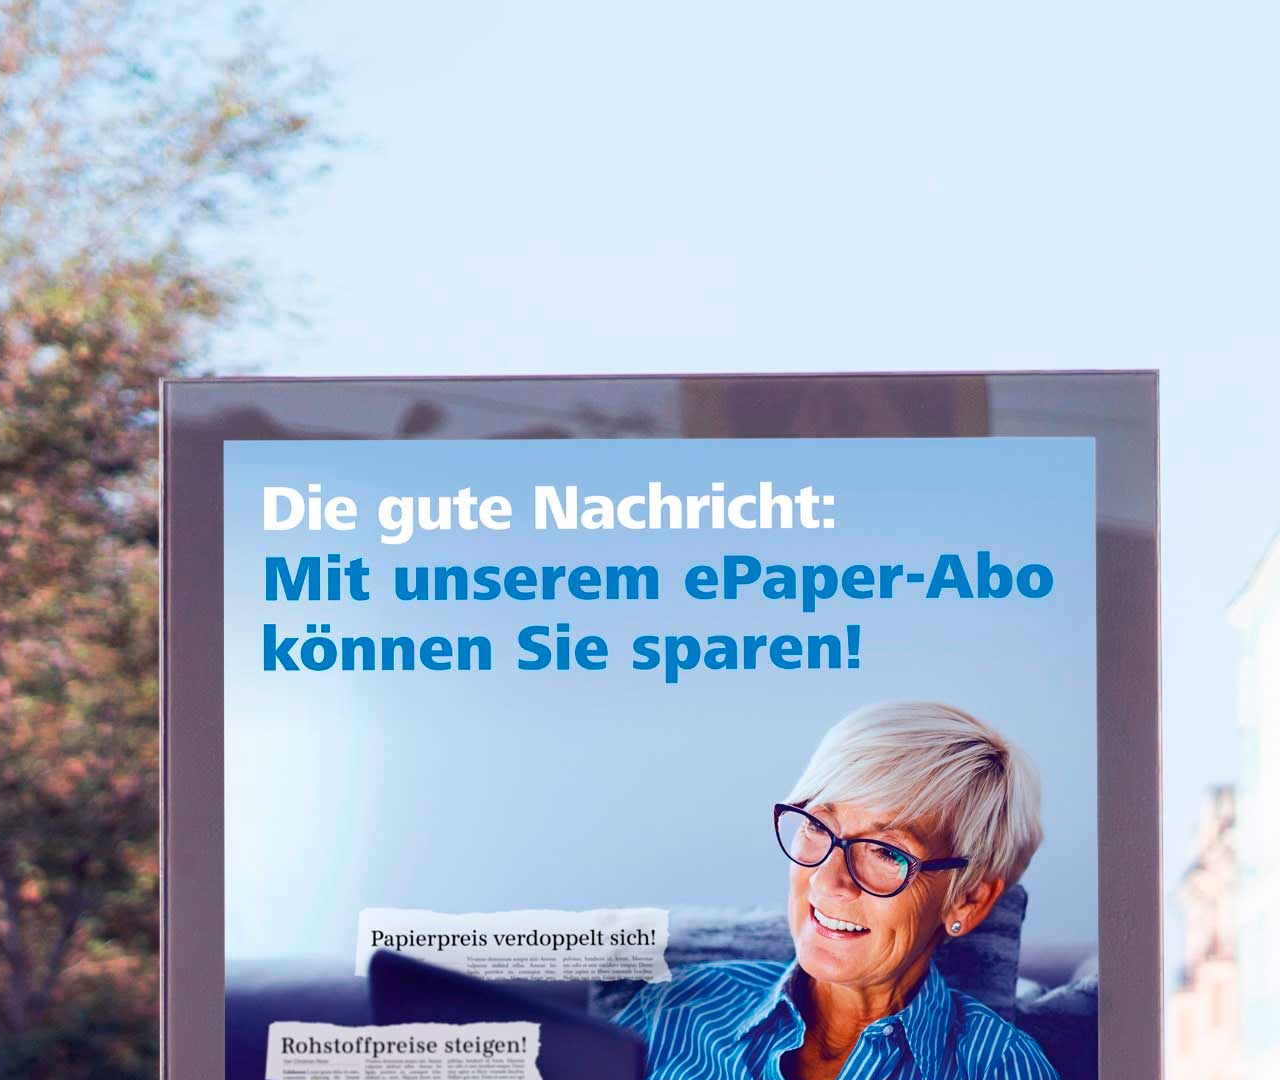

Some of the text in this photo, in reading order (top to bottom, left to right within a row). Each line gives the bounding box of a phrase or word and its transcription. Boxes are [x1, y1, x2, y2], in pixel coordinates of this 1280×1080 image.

[264, 482, 834, 544] Die gute Nachricht:
[266, 551, 1053, 612] Mit unserem ePaper-Abo
[264, 623, 860, 683] können Sie sparen!
[371, 929, 656, 950] Papierpreis verdoppelt sich!
[281, 1037, 526, 1058] Rohstoffpreise steigen!
